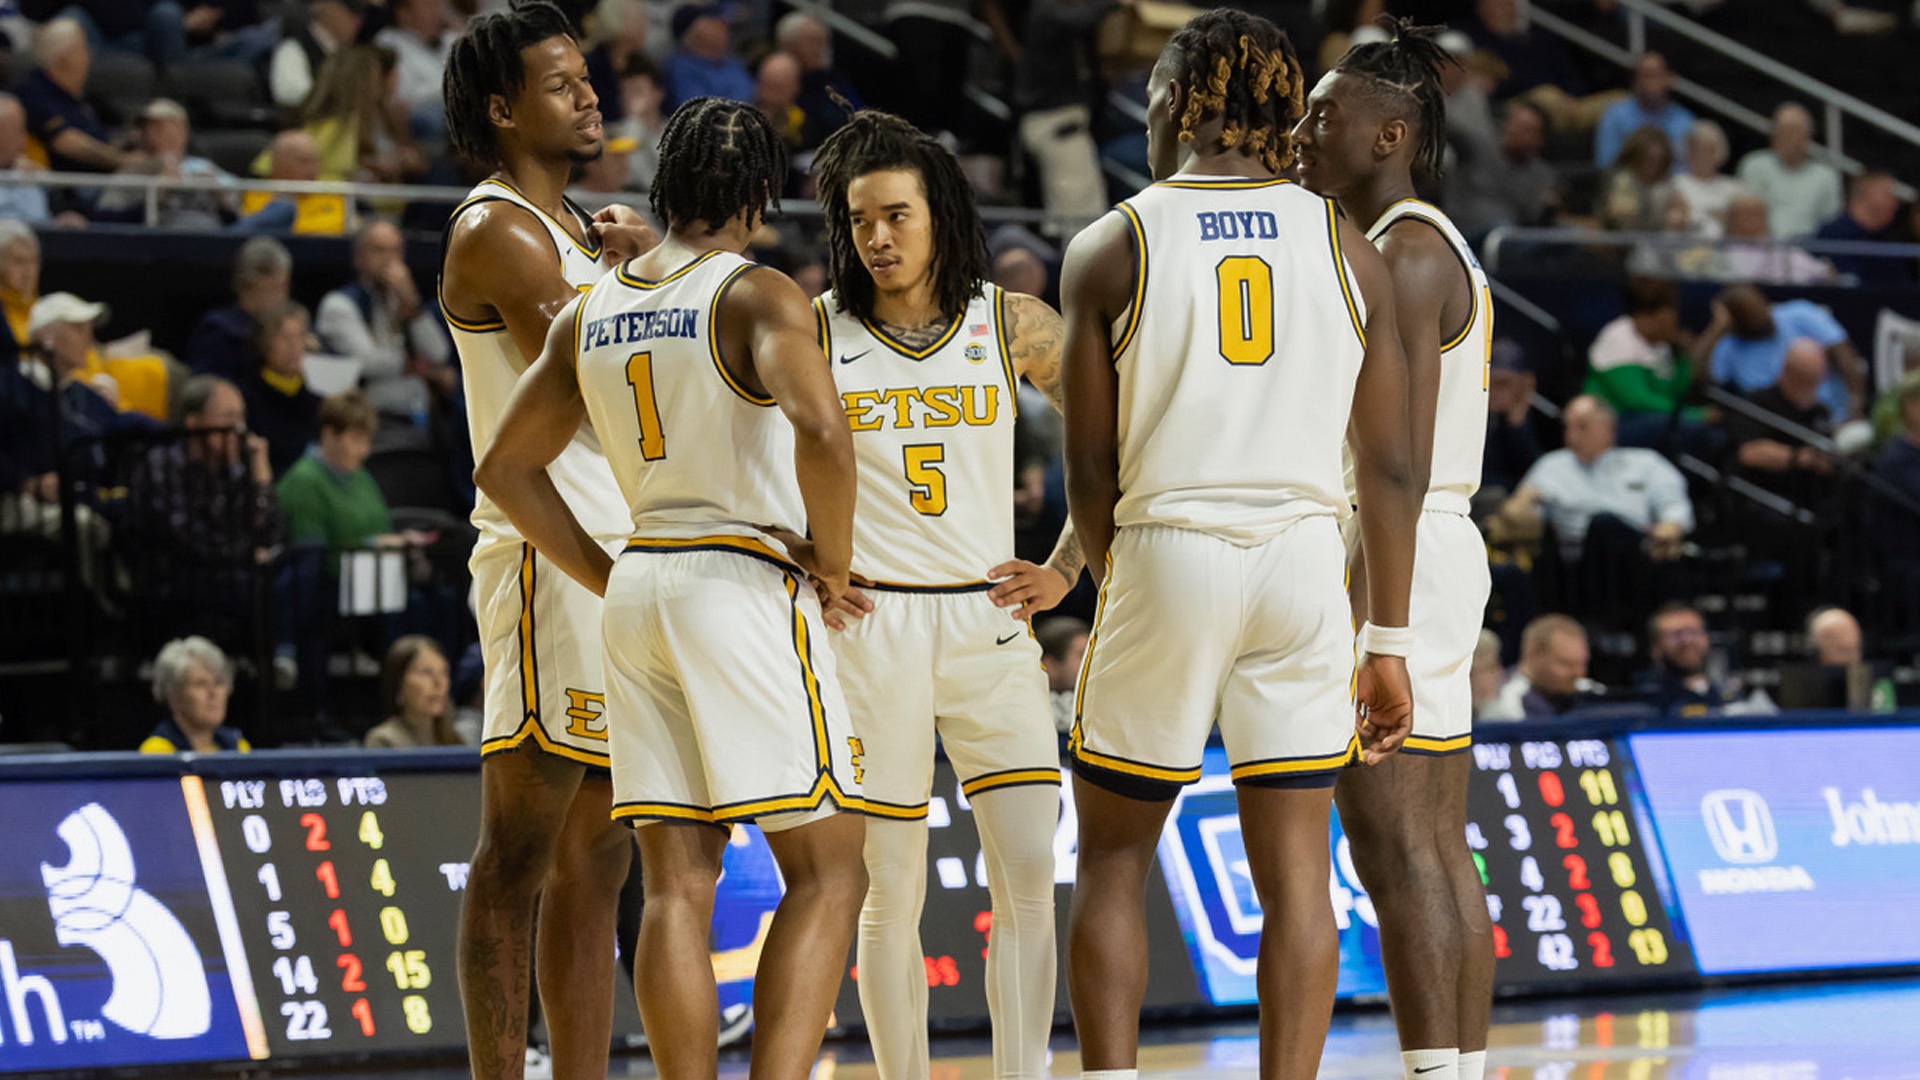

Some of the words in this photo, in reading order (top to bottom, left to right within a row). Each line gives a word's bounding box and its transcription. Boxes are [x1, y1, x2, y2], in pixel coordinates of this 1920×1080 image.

[1197, 211, 1278, 241] BOYD
[584, 307, 699, 352] PETERSON
[1216, 255, 1275, 366] 0
[625, 350, 666, 462] 1
[843, 384, 999, 432] ETSU
[903, 443, 949, 516] 5
[221, 780, 266, 808] PLY
[280, 778, 327, 806] FLS
[337, 777, 388, 805] PTS
[1496, 772, 1521, 809] 1
[1579, 769, 1618, 805] 11
[241, 814, 271, 853] 0
[300, 812, 331, 851] 2
[358, 811, 384, 849] 4
[1504, 814, 1532, 851] 3
[1550, 812, 1579, 849] 2
[1592, 809, 1631, 846] 11
[257, 862, 281, 901] 1
[315, 860, 340, 899] 1
[370, 858, 396, 897] 4
[1520, 855, 1544, 892] 4
[1563, 853, 1591, 890] 2
[267, 910, 296, 950] 5
[328, 908, 353, 947] 1
[379, 906, 409, 944] 0
[1522, 894, 1567, 931] 22
[1575, 892, 1602, 929] 3
[1587, 931, 1615, 968] 2
[272, 955, 319, 995] 14
[336, 953, 367, 992] 2
[386, 950, 432, 990] 15
[280, 1000, 332, 1040] 22
[351, 998, 376, 1037] 1
[402, 995, 432, 1034] 8
